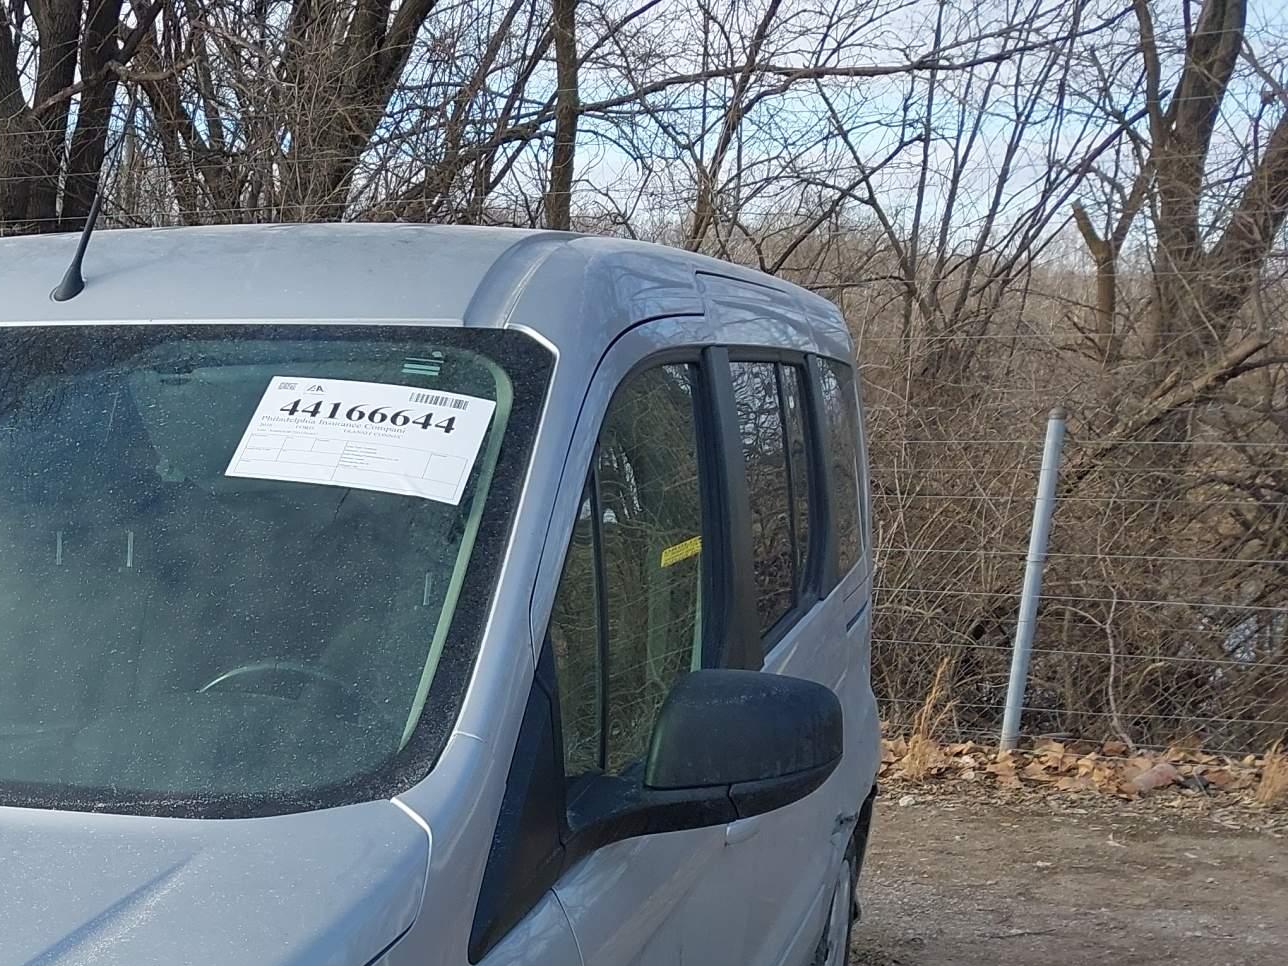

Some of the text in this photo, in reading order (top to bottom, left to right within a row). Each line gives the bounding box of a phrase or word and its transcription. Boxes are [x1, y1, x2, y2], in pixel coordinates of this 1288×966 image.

[261, 414, 316, 425] Philadelphia
[318, 419, 362, 430] Insurance
[279, 397, 457, 435] 44166644
